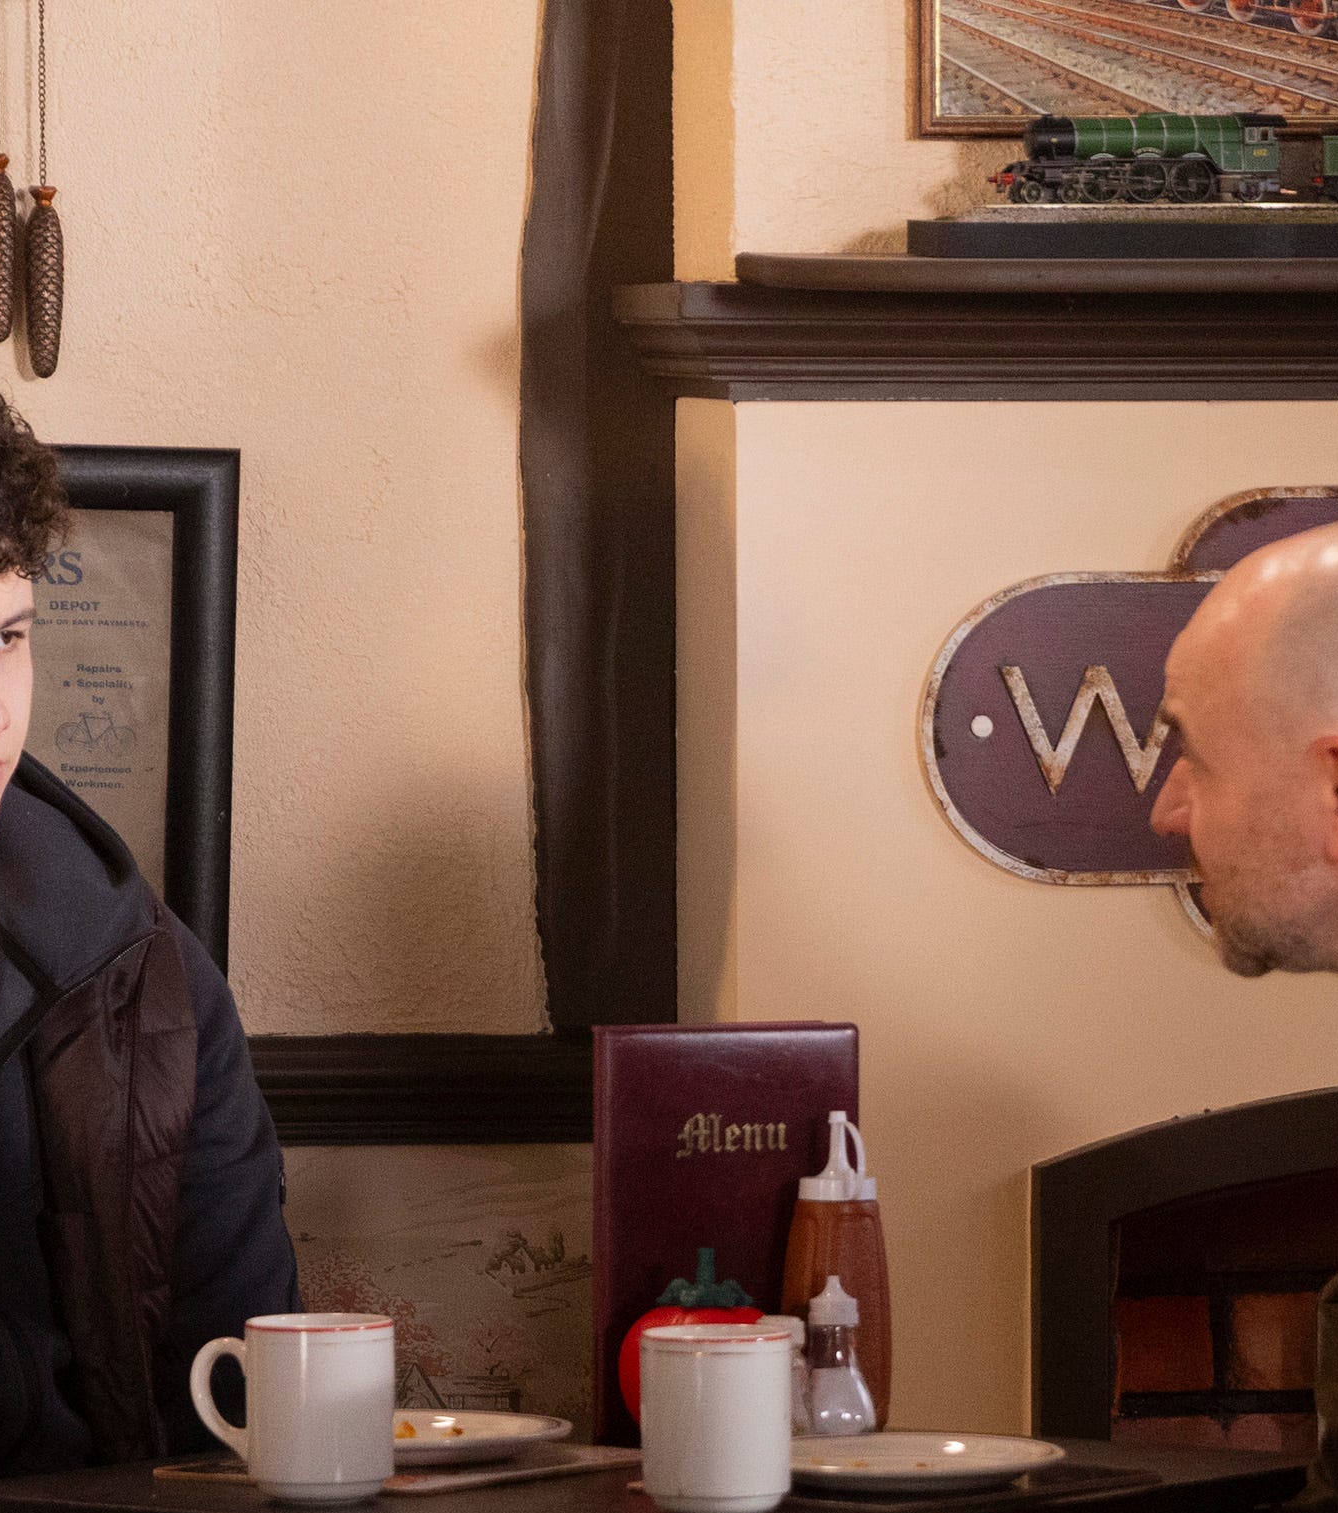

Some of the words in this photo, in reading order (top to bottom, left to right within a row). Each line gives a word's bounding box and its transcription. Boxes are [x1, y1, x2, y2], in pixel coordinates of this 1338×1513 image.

[48, 600, 101, 611] DEPOT
[76, 663, 123, 675] Repairs
[91, 694, 106, 705] by
[676, 1111, 789, 1159] Menu
